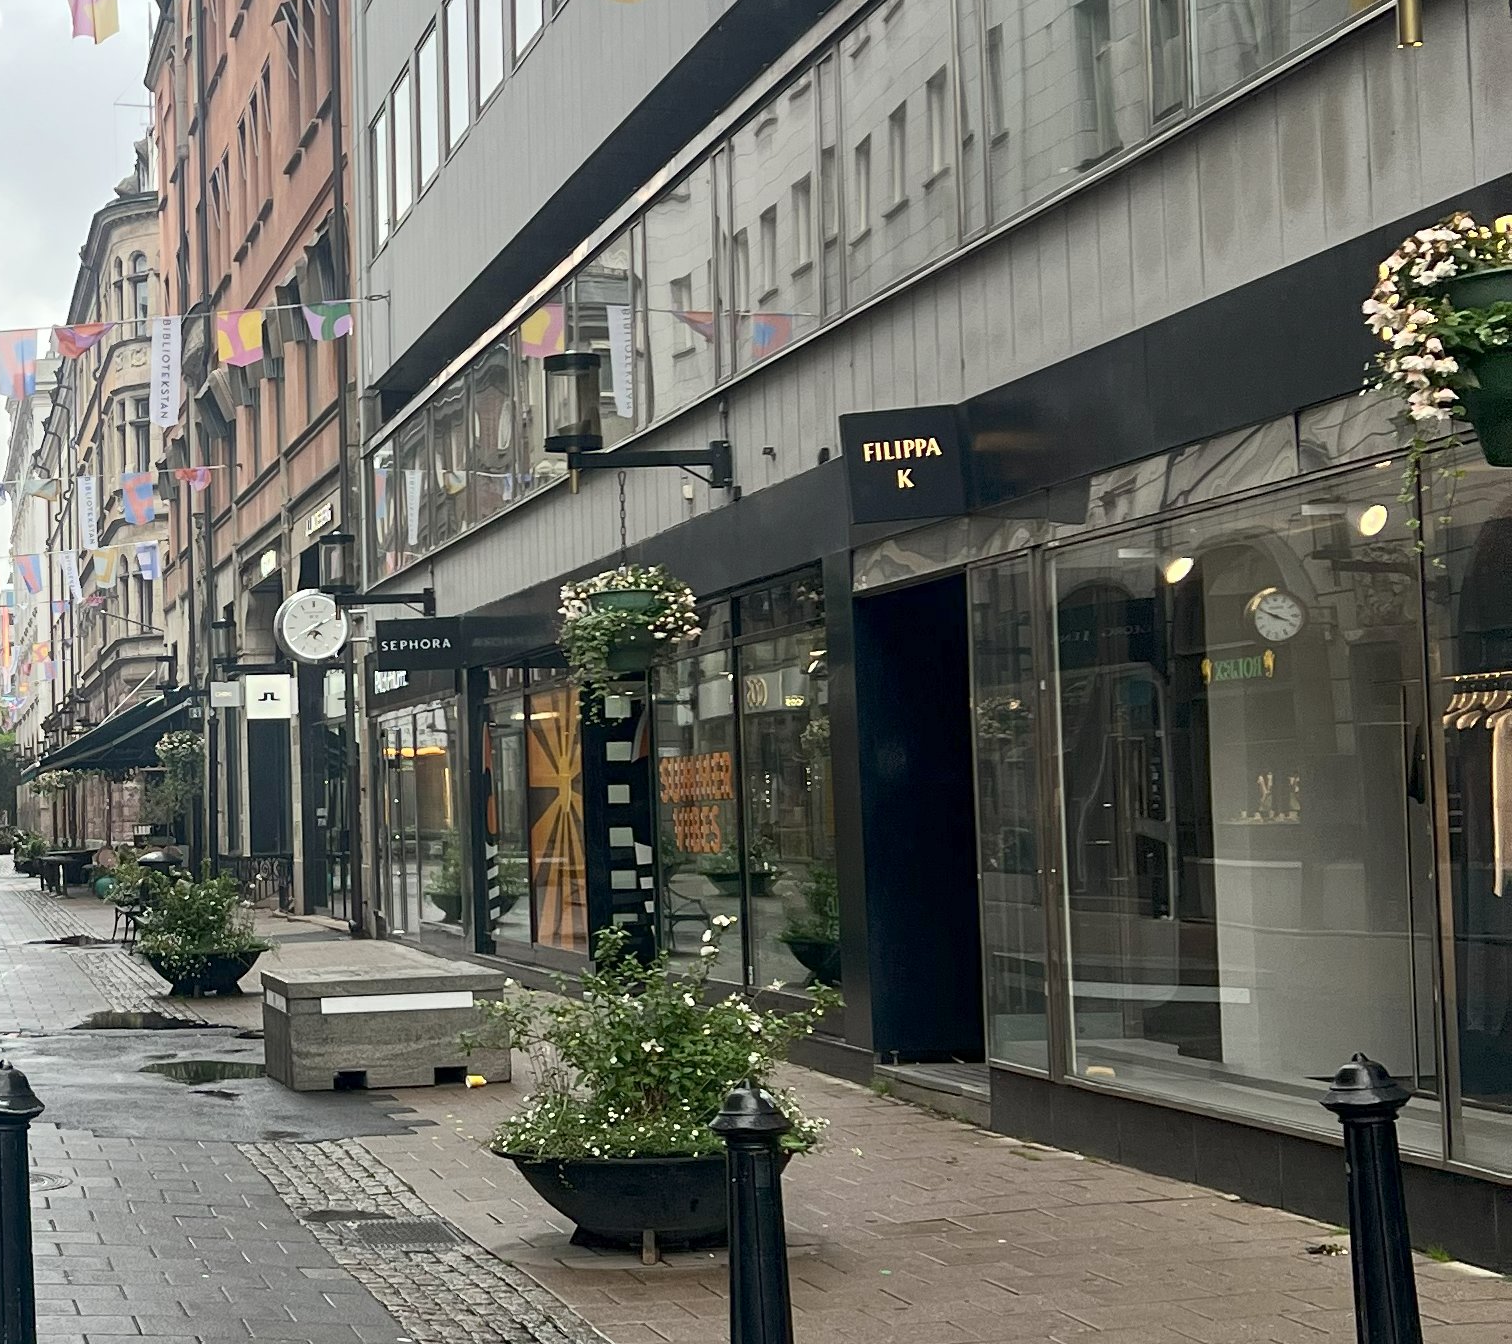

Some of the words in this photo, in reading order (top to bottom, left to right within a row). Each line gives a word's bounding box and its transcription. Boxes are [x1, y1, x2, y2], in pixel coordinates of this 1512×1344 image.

[160, 318, 172, 420] BIBLIOTEKSTAN
[863, 437, 943, 462] FILIPPA
[897, 468, 916, 489] K
[381, 638, 452, 652] SEPHORA
[659, 752, 733, 803] SUMMER
[673, 805, 723, 854] VIBES
